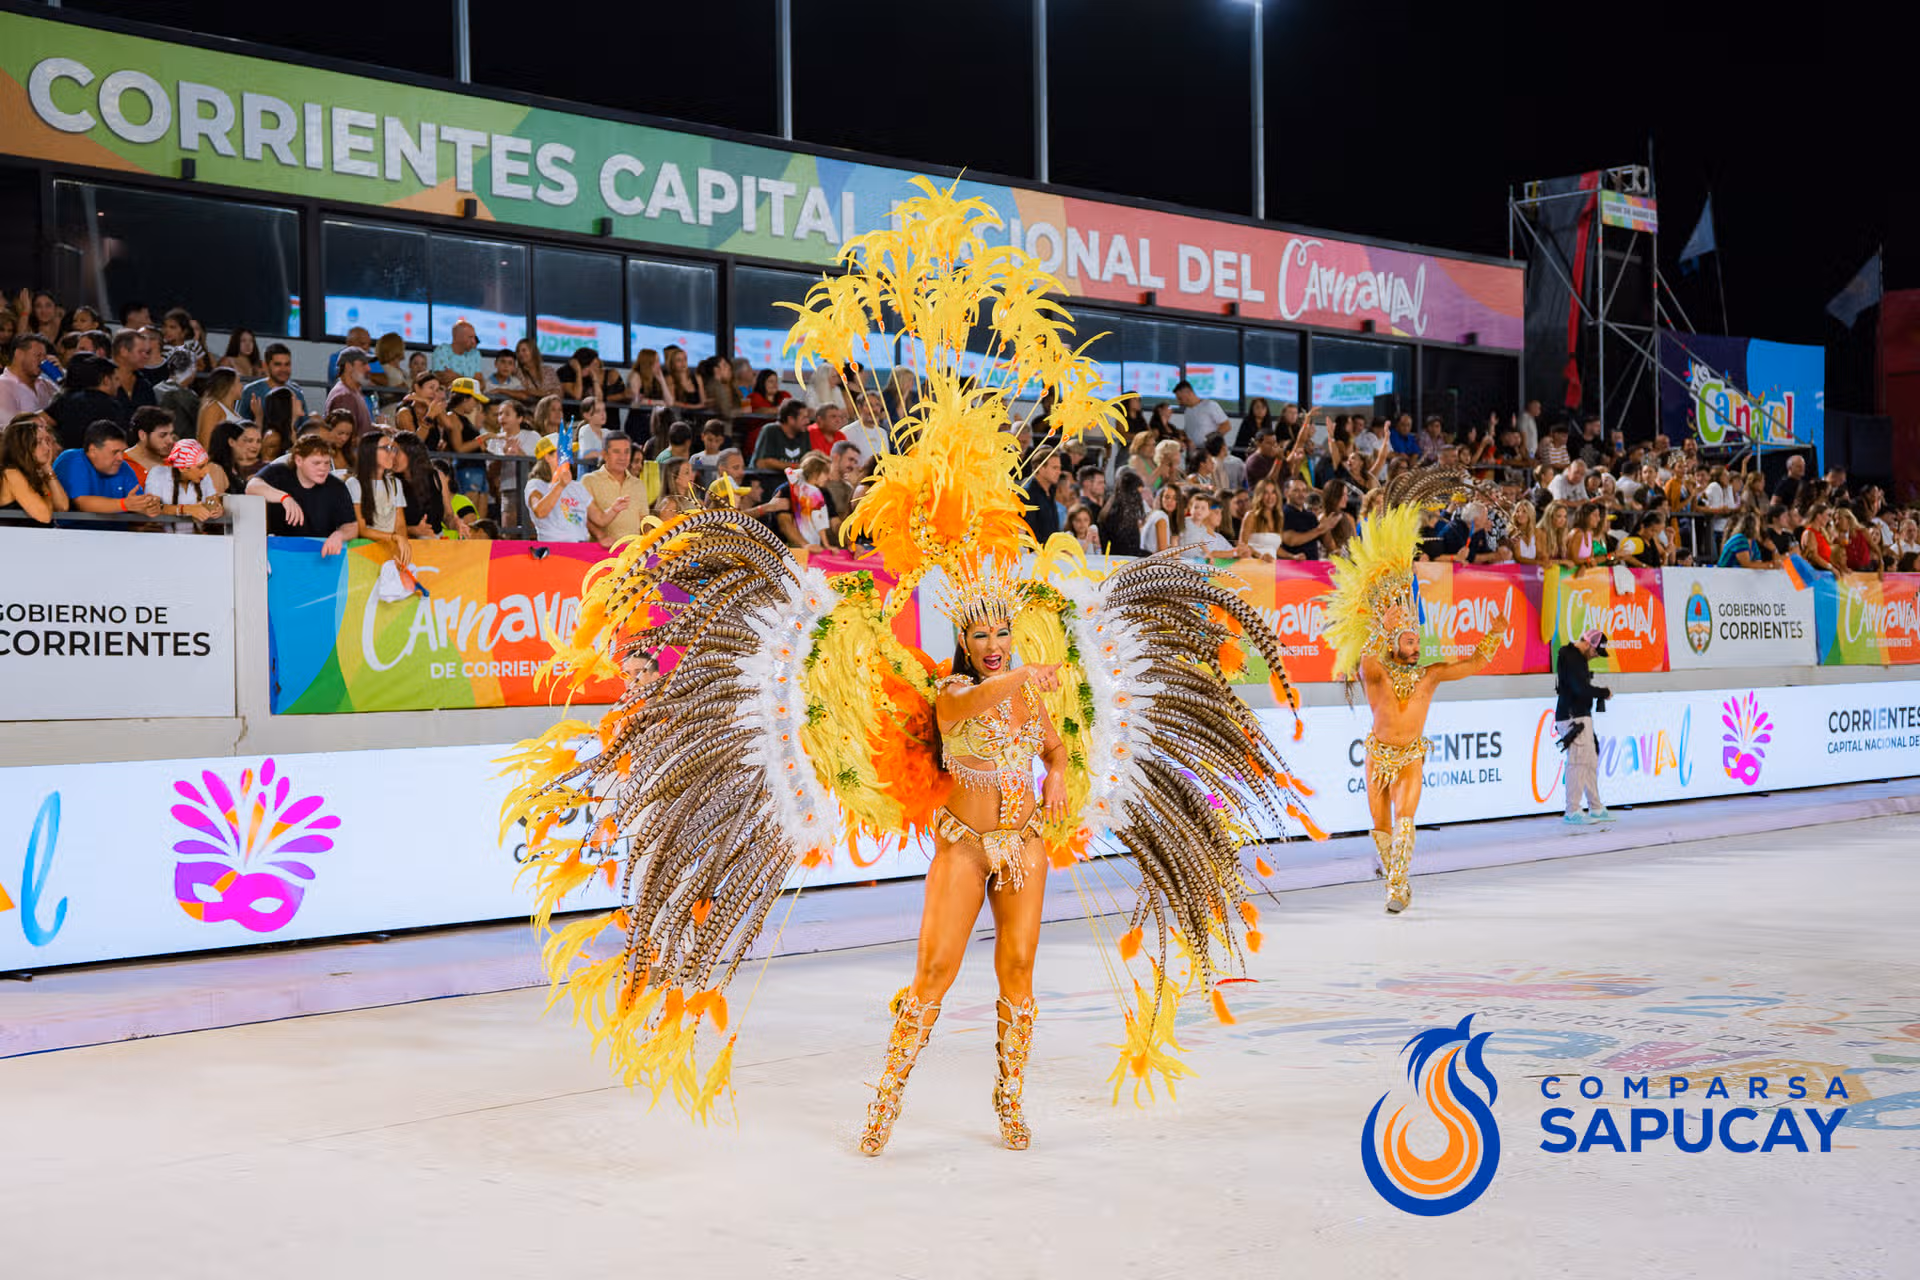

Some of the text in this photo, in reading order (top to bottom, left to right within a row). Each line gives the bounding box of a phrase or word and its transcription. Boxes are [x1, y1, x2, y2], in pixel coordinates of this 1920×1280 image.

[27, 56, 580, 207] CORRIENTES
[599, 152, 864, 248] CAPITAL
[1177, 242, 1265, 303] DEL
[1700, 381, 1794, 443] Carnaval
[0, 603, 168, 624] OBIERNO DE
[1718, 603, 1787, 617] GOBIERNO DE
[1720, 621, 1803, 640] CORRIENTES
[1425, 646, 1439, 657] DE
[430, 662, 456, 678] DE
[1348, 731, 1503, 767] CENTES
[1827, 739, 1862, 754] CAPITAL
[1864, 736, 1907, 751] NACIONAL
[1479, 767, 1502, 783] DEL
